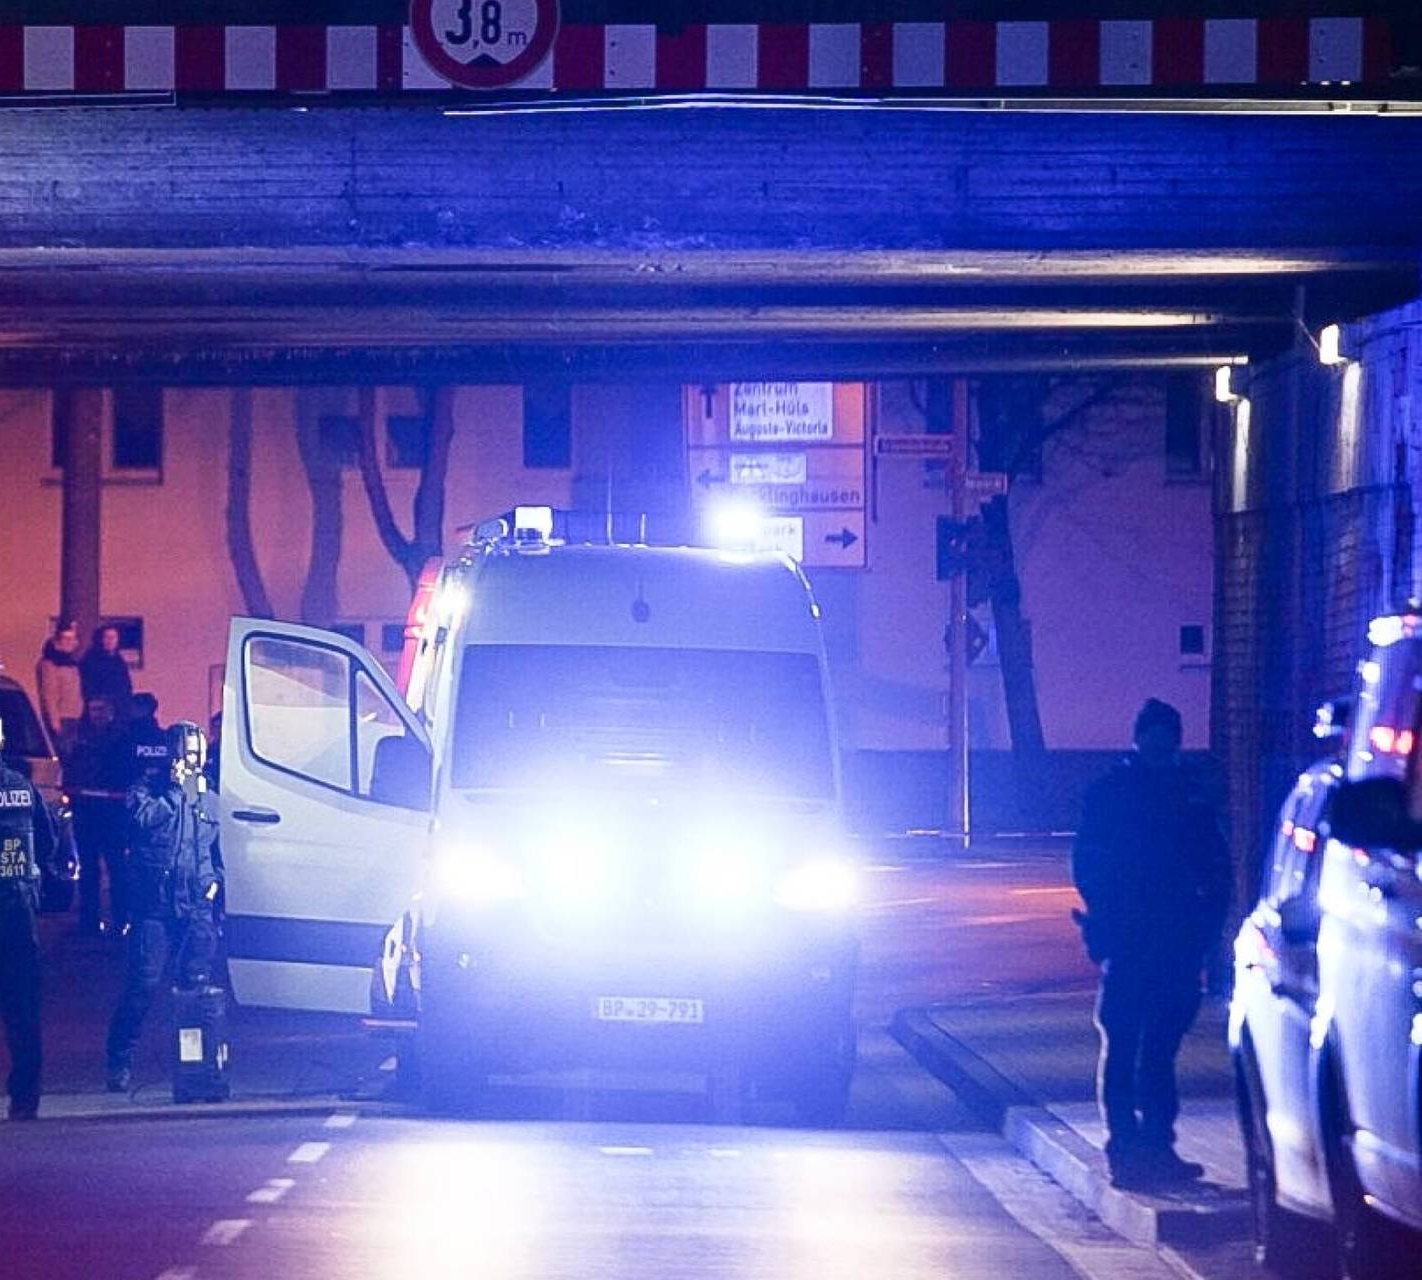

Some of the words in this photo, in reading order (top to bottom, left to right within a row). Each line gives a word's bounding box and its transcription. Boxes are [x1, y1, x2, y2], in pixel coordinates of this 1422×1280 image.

[445, 0, 501, 49] 3,8
[508, 32, 527, 45] m
[734, 382, 798, 396] Zentrum
[3, 839, 22, 851] BP
[0, 851, 27, 864] STA
